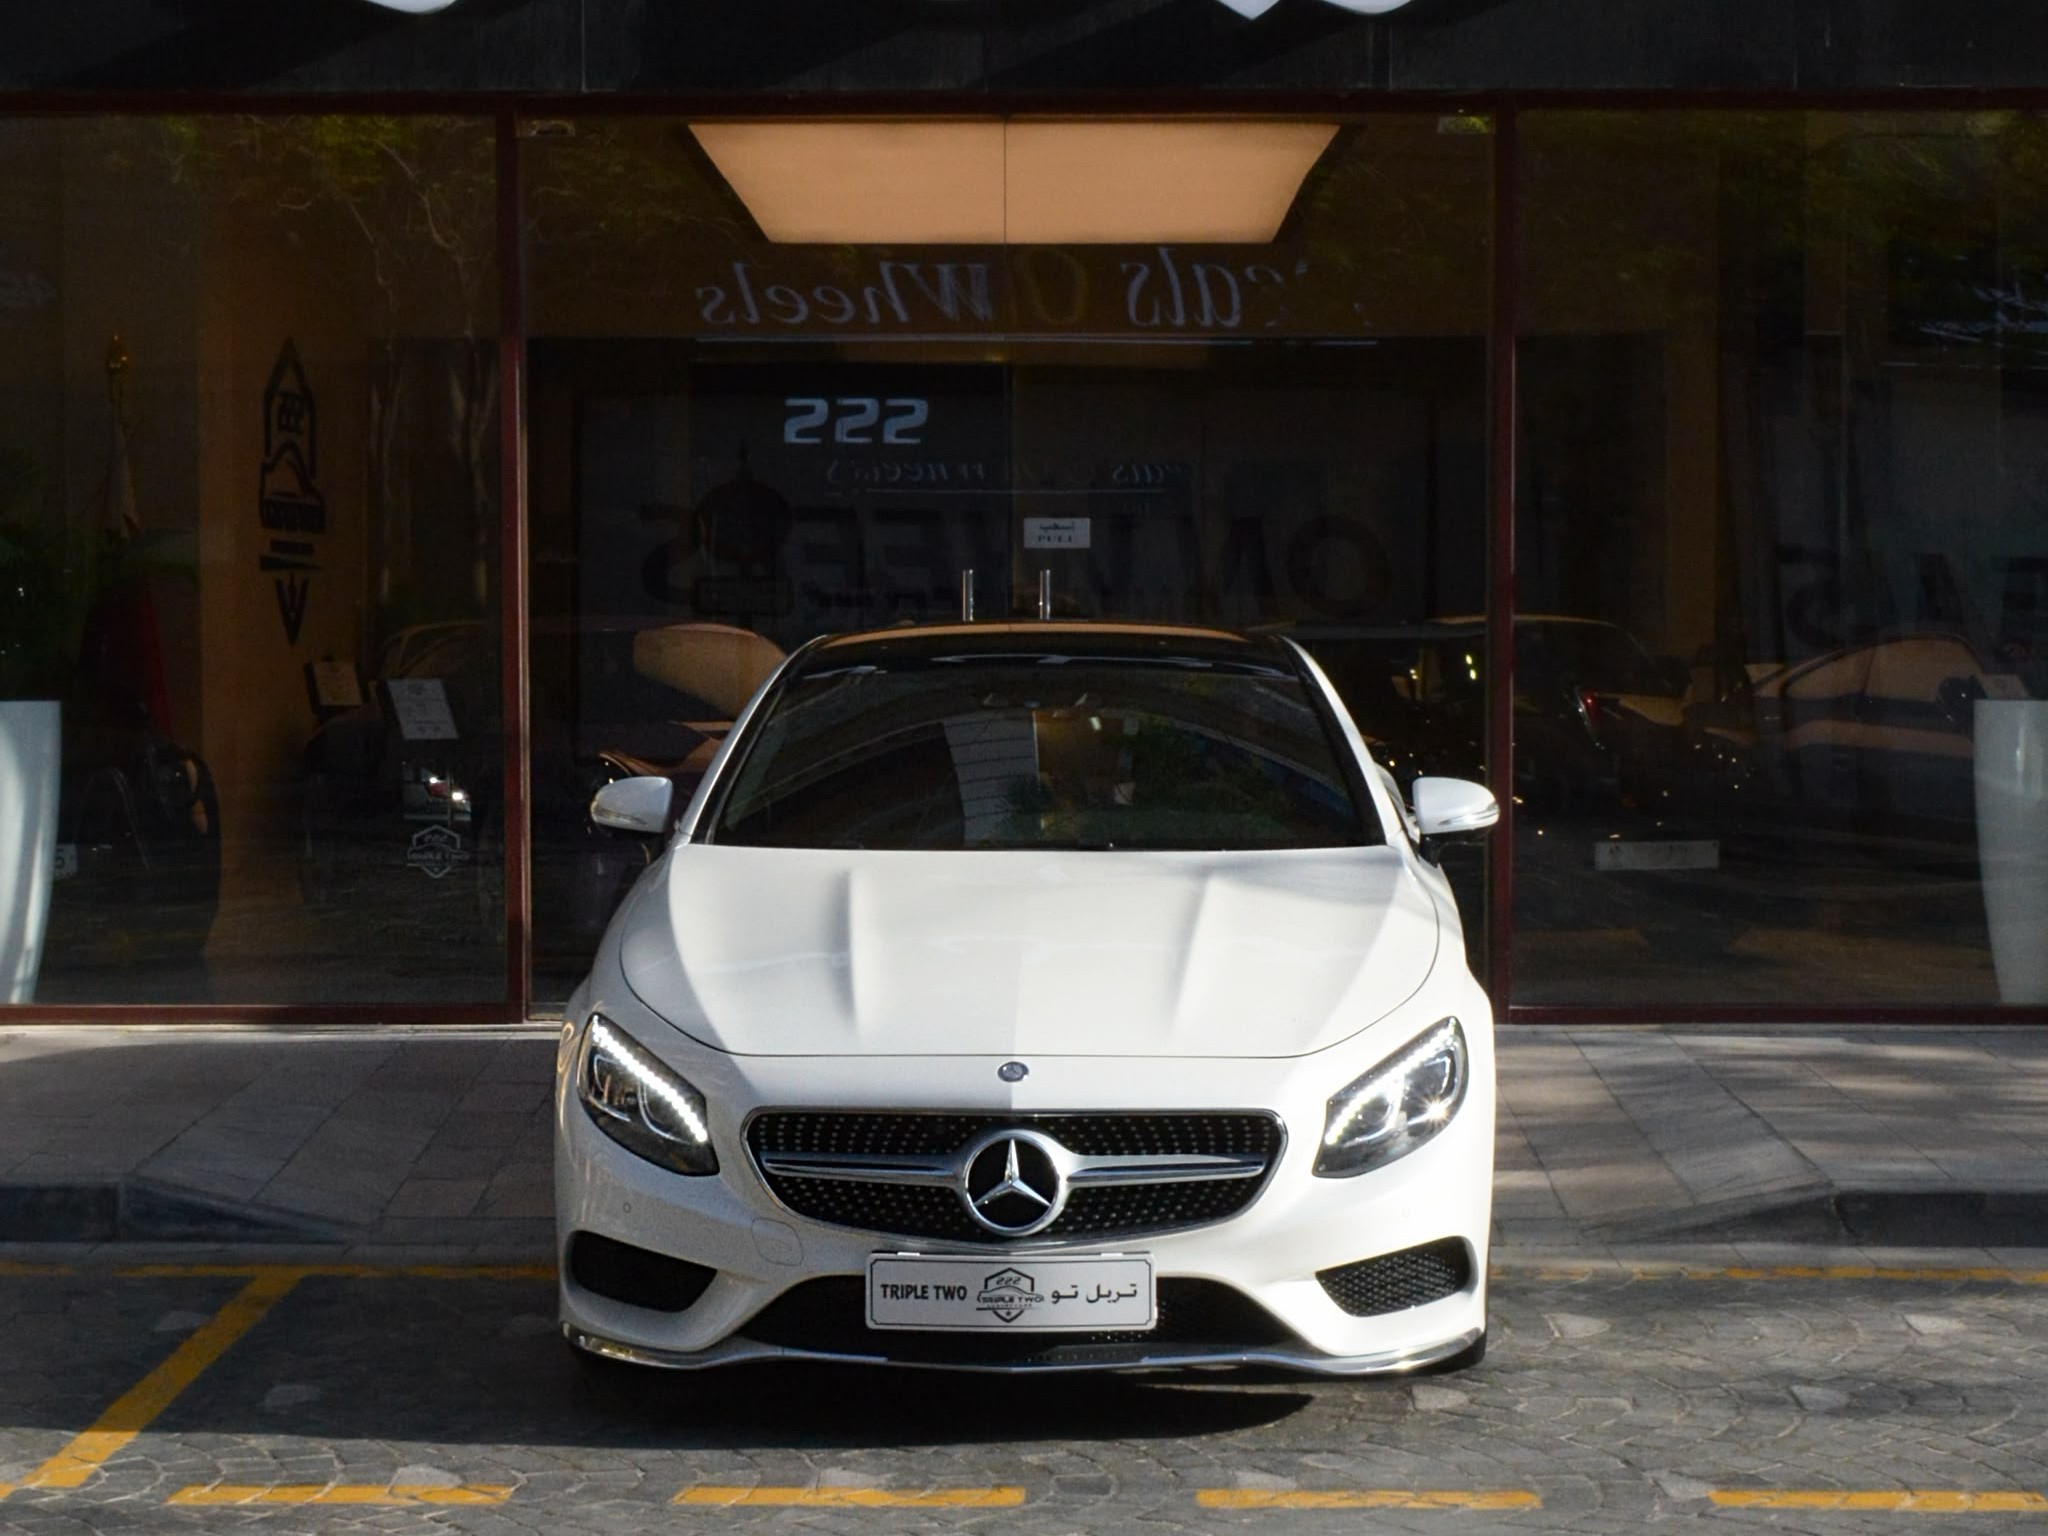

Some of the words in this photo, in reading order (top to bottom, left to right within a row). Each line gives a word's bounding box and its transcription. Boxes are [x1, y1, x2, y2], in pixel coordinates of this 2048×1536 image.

[784, 397, 929, 444] 222
[880, 1283, 929, 1301] TRIPLE
[932, 1284, 968, 1302] TWO
[1051, 1284, 1080, 1305] تو
